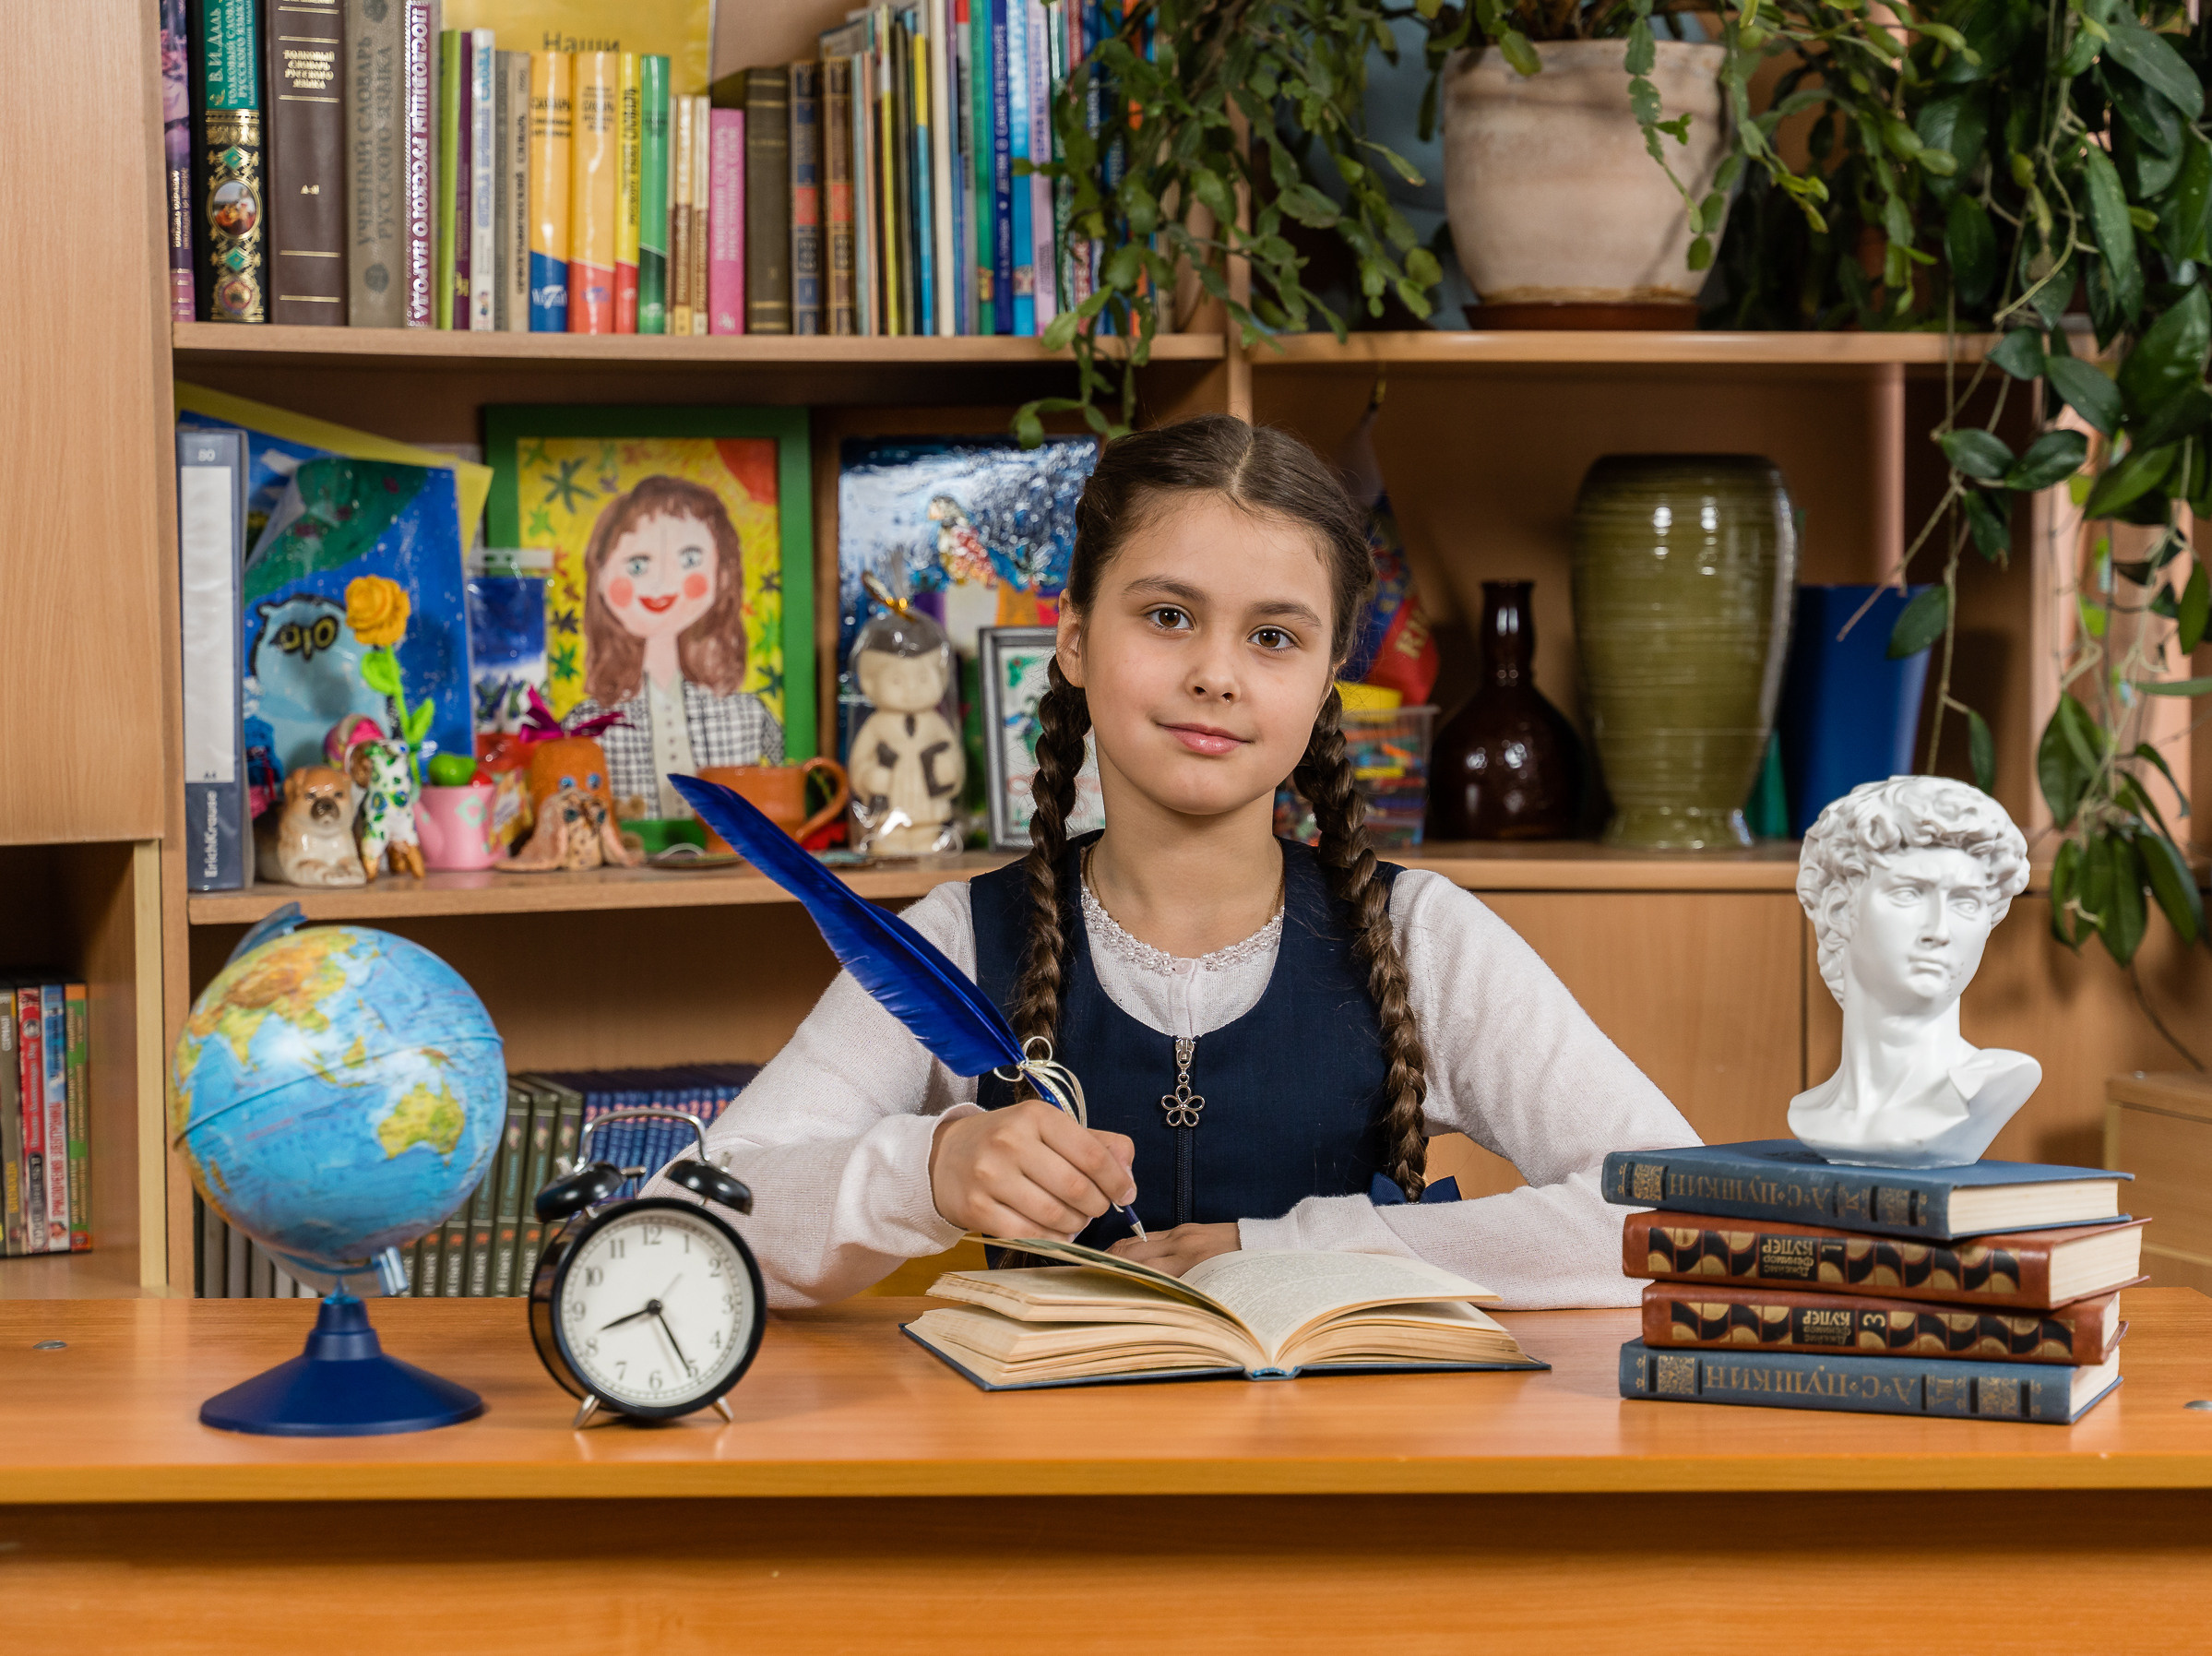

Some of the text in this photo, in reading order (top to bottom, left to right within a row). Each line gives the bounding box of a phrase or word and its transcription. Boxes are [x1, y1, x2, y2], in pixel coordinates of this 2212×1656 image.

[225, 41, 238, 105] ТОЛКОВЫЙ
[236, 37, 247, 98] РУССКОГО
[356, 36, 373, 133] СЛОВАРЬ
[376, 46, 395, 240] РУССКОГО ЯЗЫКА
[410, 7, 430, 319] ПОСЛОВИЦЫ РУССКОГО НАРОДА
[203, 790, 218, 878] ErichKrause
[1668, 1173, 1778, 1205] ПУШКИН
[642, 1224, 662, 1245] 12
[683, 1233, 691, 1254] 1
[610, 1239, 625, 1258] 11
[1762, 1238, 1814, 1256] КУПЕР
[708, 1258, 721, 1278] 2
[1763, 1255, 1814, 1267] Фенимор
[585, 1267, 603, 1287] 10
[572, 1302, 586, 1322] 9
[722, 1294, 734, 1315] 3
[1802, 1310, 1850, 1326] КУПЕР
[1862, 1314, 1886, 1328] 3
[585, 1339, 599, 1358] 8
[709, 1329, 721, 1350] 4
[615, 1361, 628, 1381] 7
[687, 1360, 699, 1378] 5
[648, 1370, 662, 1391] 6
[1704, 1365, 1849, 1397] ПУШКИН
